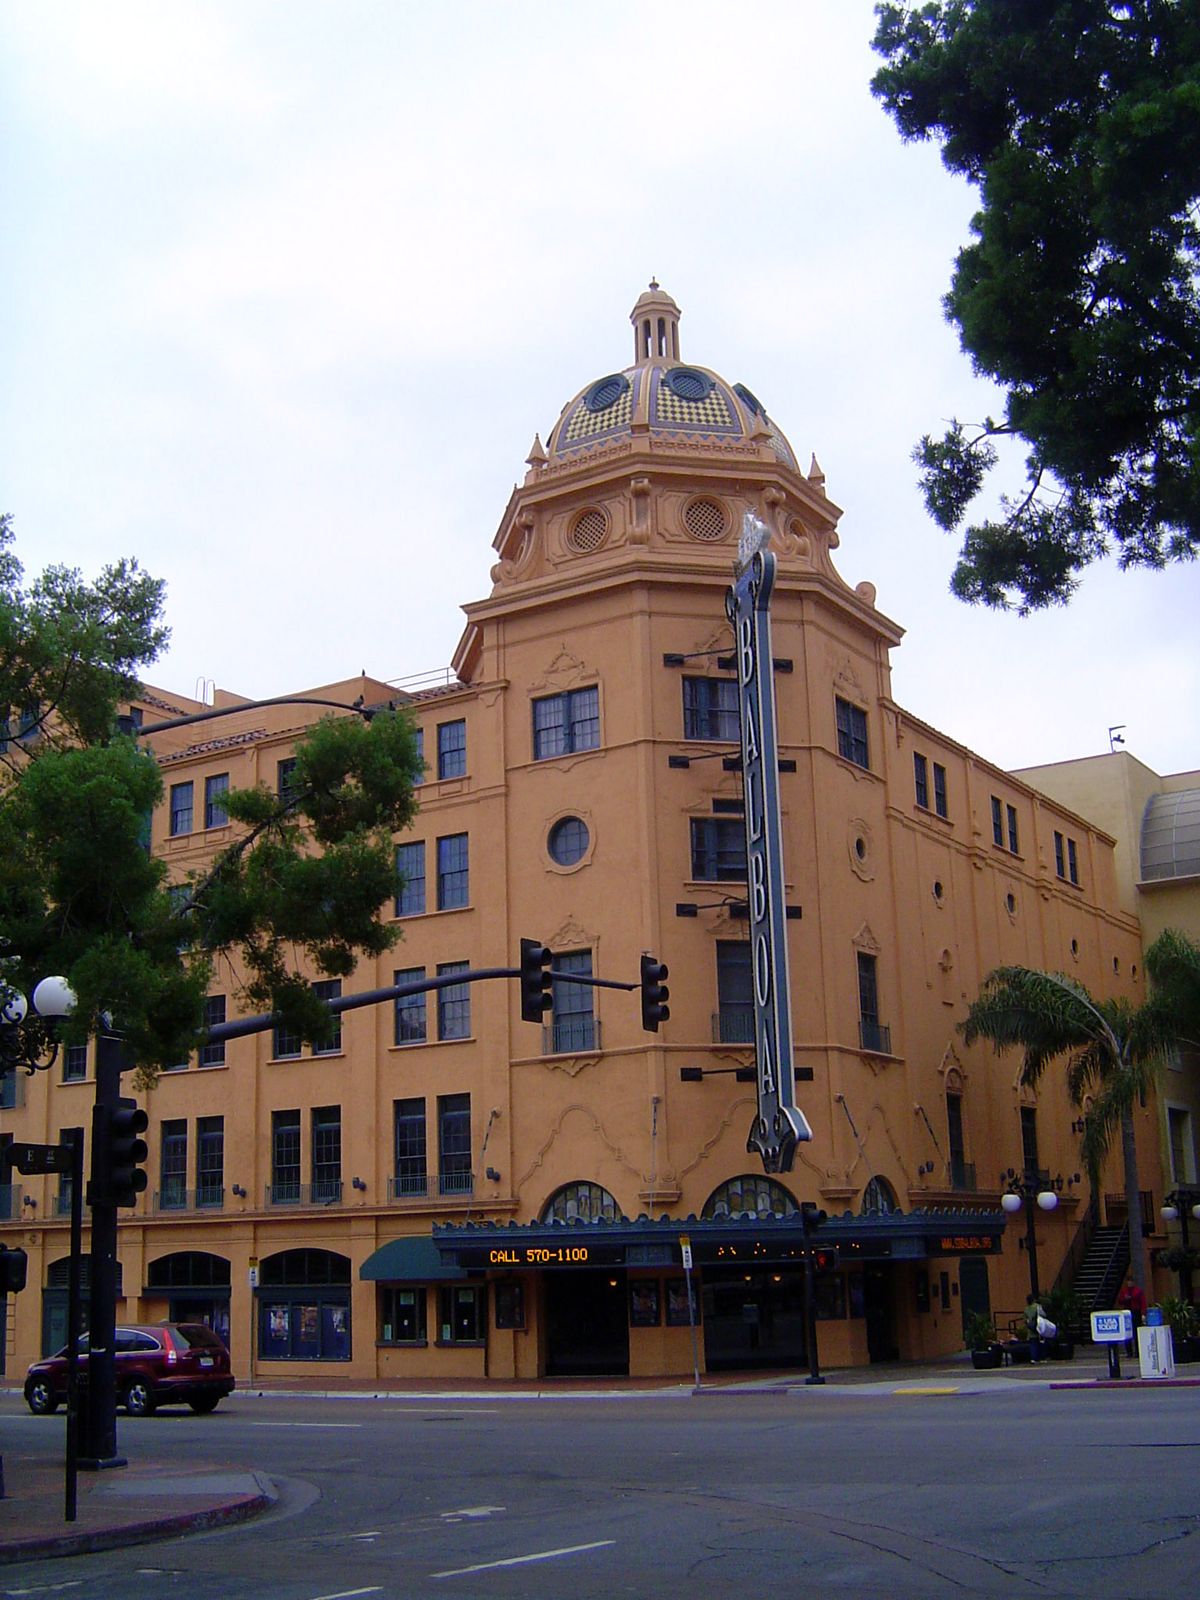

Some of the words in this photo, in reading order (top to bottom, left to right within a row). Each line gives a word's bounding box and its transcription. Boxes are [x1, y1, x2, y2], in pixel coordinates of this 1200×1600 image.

[738, 617, 775, 1095] BALBOA
[27, 1150, 34, 1161] E
[490, 1250, 520, 1263] CALL
[526, 1247, 588, 1262] 570-1100
